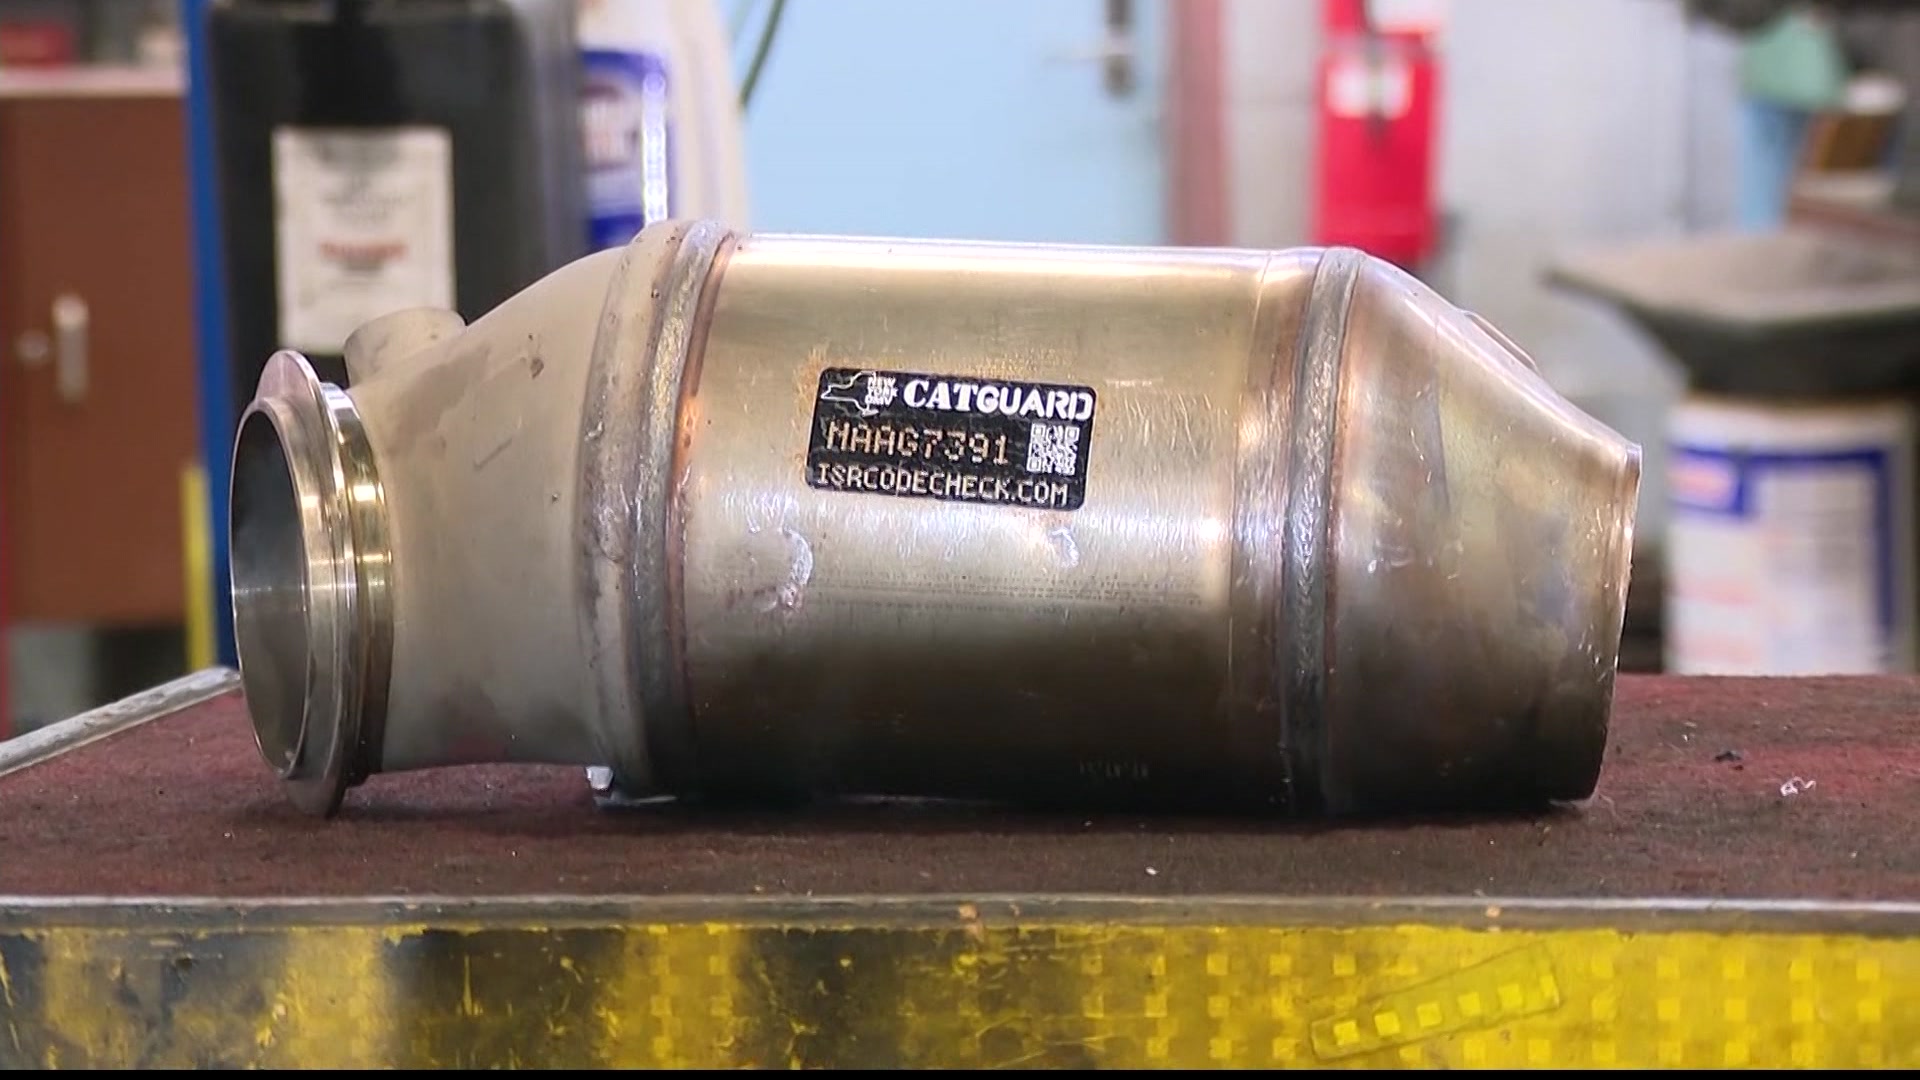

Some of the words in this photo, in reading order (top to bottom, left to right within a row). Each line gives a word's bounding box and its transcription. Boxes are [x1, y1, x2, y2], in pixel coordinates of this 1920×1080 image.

[903, 379, 1092, 420] CATGUARD
[827, 417, 1008, 465] MAAG7391
[817, 464, 1068, 506] ISRCODECHECK.COM
